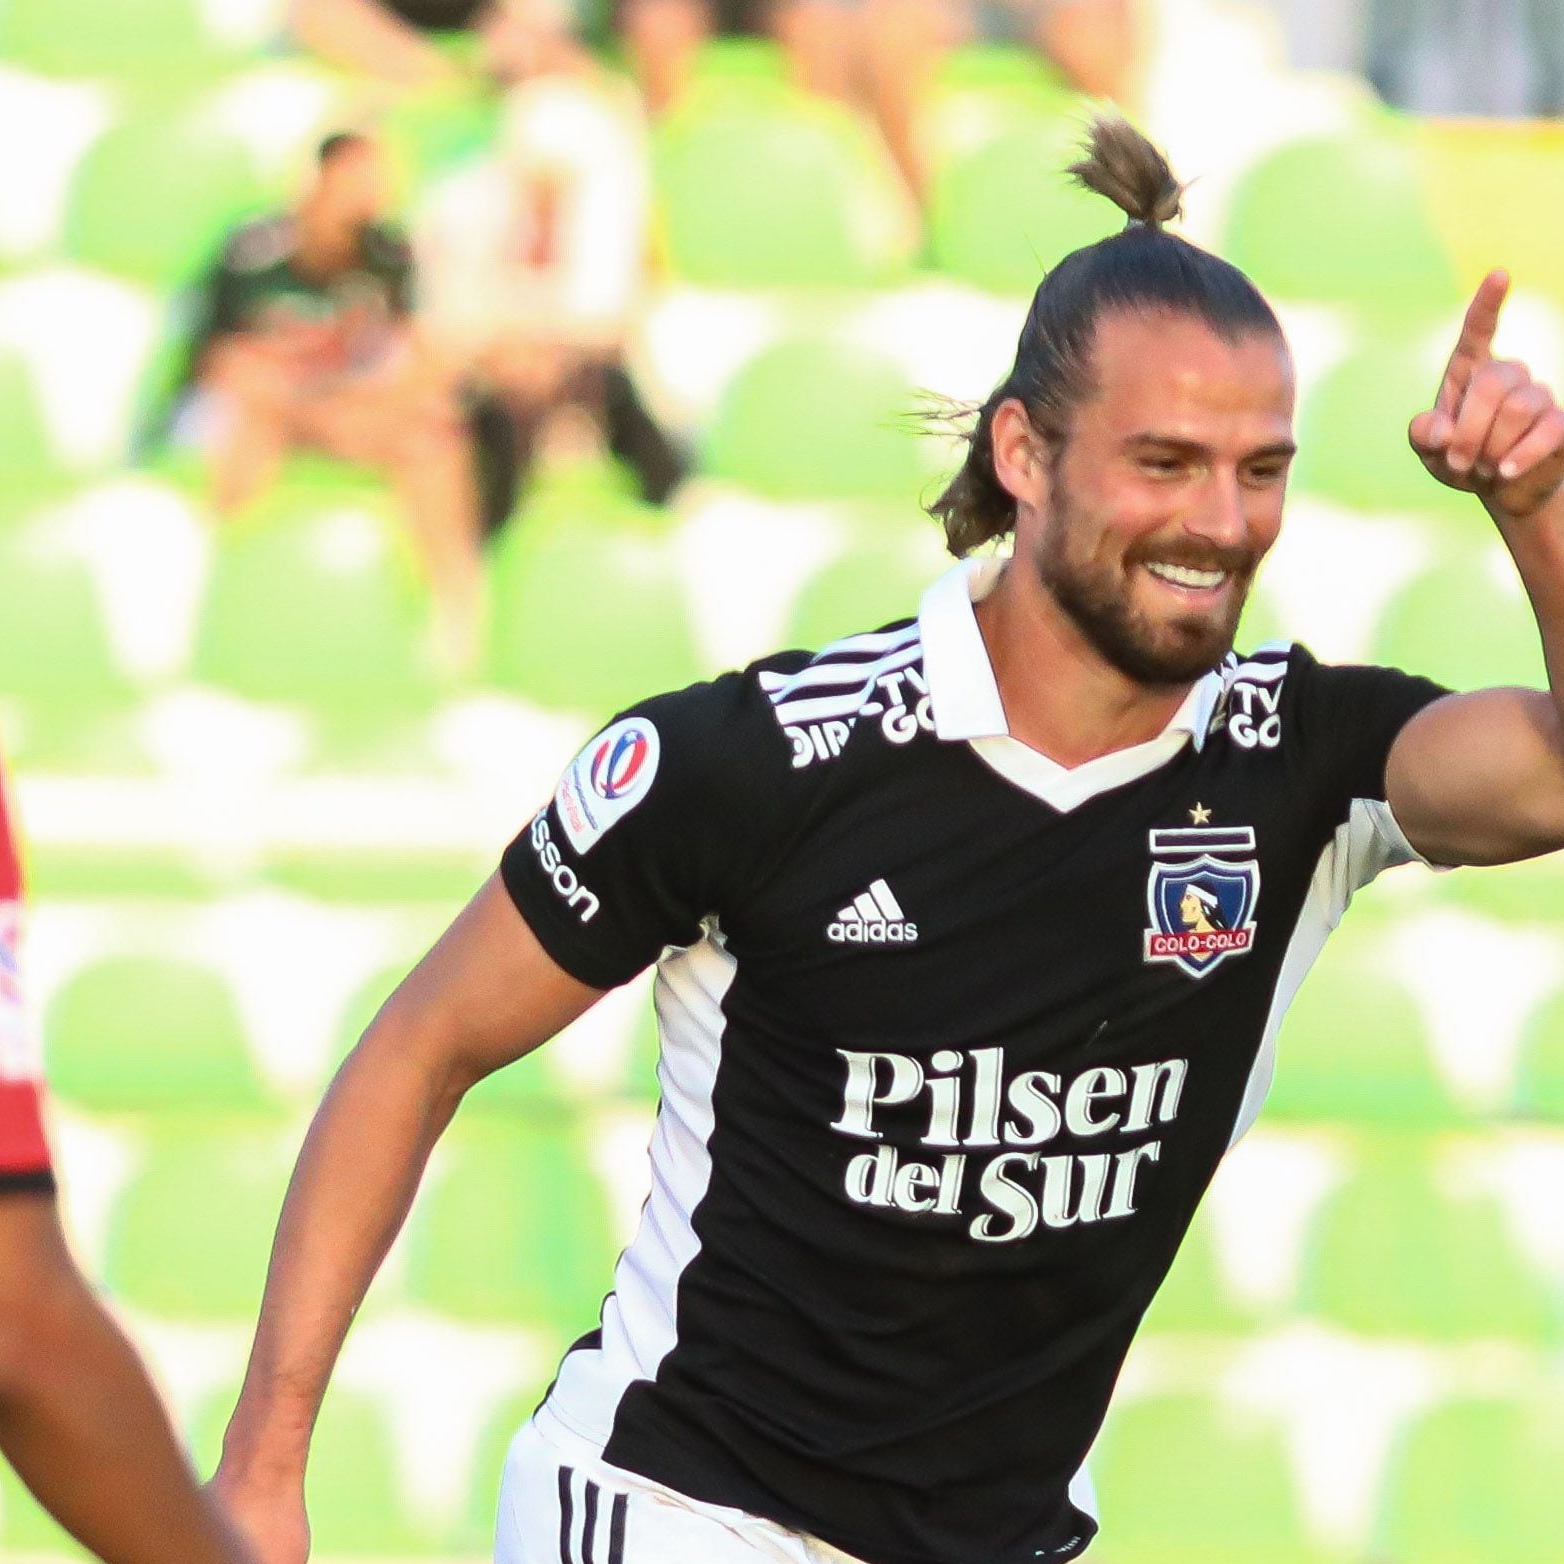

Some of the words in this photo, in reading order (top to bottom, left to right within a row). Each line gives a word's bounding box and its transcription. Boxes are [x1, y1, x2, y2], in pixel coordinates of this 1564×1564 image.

[1234, 680, 1283, 714] TV
[1228, 712, 1281, 748] GO
[827, 918, 919, 943] adidas
[1153, 930, 1247, 953] COLO-COLO
[829, 1045, 1189, 1147] Pilsen
[842, 1144, 968, 1215] del
[969, 1139, 1162, 1242] Sur
